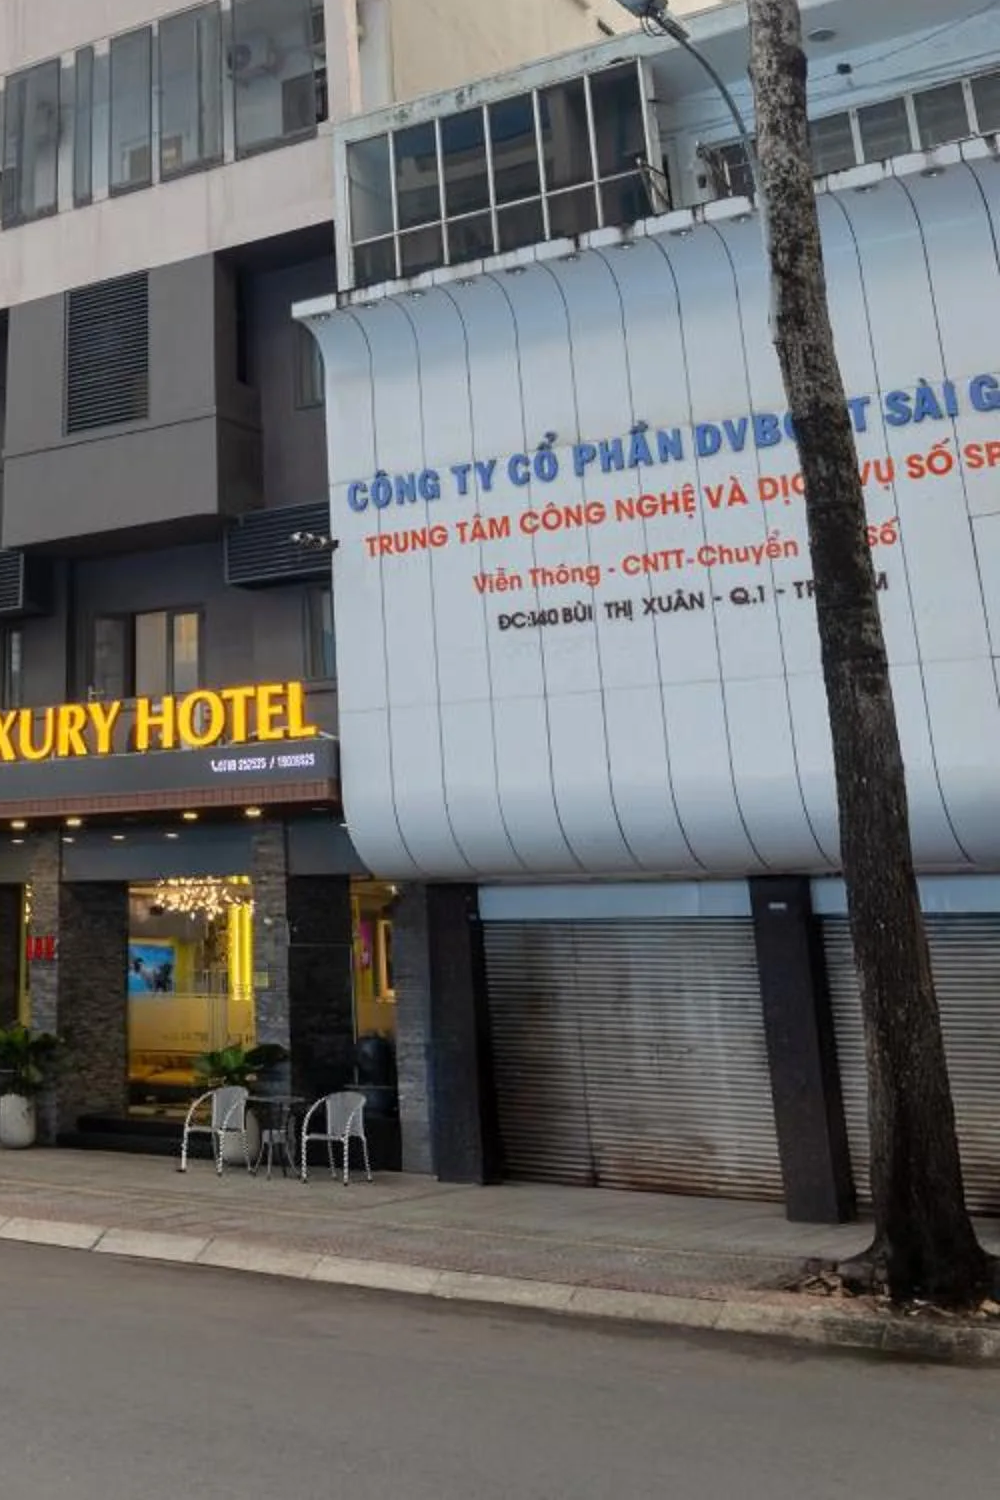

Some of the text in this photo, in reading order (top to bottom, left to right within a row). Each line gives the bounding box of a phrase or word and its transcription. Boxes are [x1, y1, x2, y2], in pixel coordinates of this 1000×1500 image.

[347, 469, 441, 512] CÔNG
[451, 460, 497, 495] TY
[508, 431, 558, 486] CỔ
[573, 419, 682, 476] PHẦN
[885, 378, 959, 427] SÀI
[365, 526, 448, 557] TRUNG
[456, 513, 511, 545] TÂM
[519, 503, 606, 535] CÔNG
[615, 483, 697, 521] NGHỆ
[704, 476, 748, 510] VÀ
[757, 472, 806, 506] DỊC
[906, 438, 954, 480] SỐ
[473, 567, 522, 595] Viễn
[529, 563, 601, 588] Thông
[562, 601, 593, 624] BÙI
[604, 600, 633, 621] THỊ
[643, 590, 705, 616] XUÂN
[729, 585, 765, 606] Q.1
[135, 680, 318, 752] HOTEL
